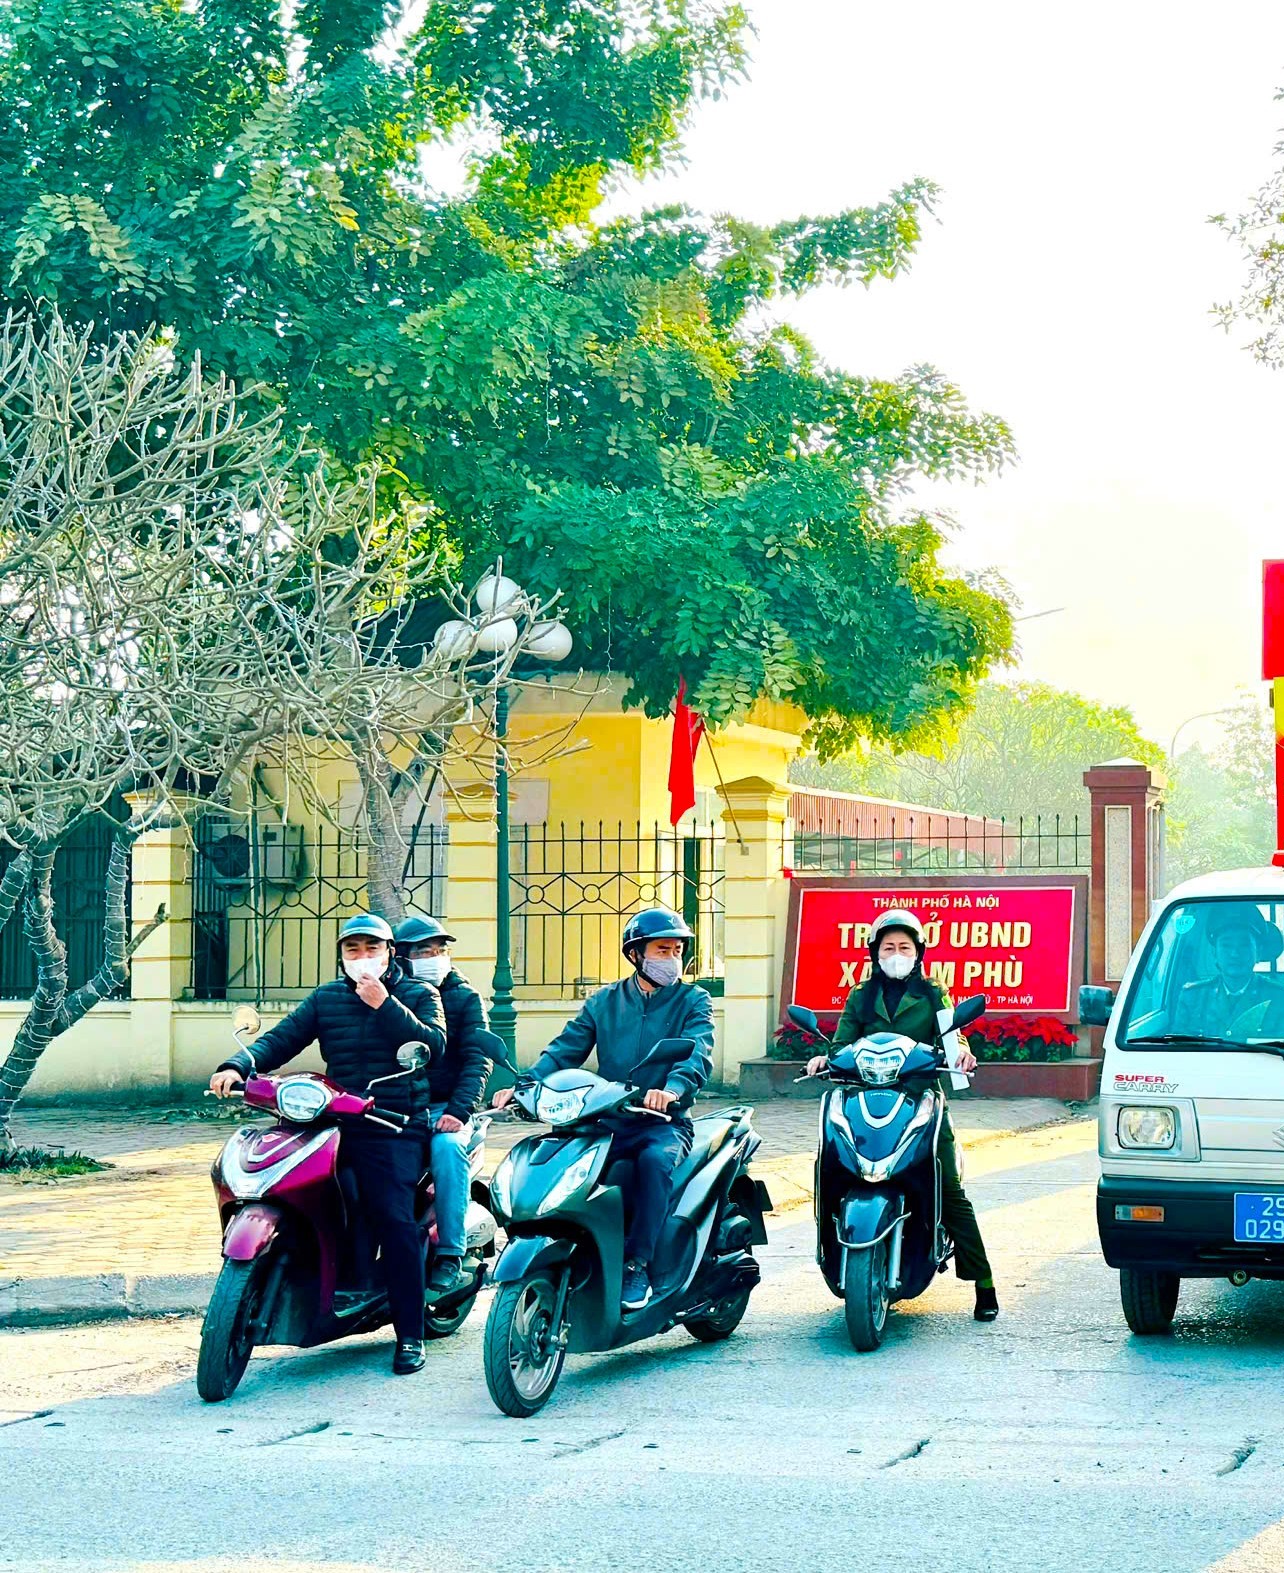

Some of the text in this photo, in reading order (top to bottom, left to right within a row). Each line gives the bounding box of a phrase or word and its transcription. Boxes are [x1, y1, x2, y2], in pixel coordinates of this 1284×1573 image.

[872, 893, 1000, 910] THÀNH PHỐ HÀ NỘI
[838, 923, 872, 949] TR
[949, 921, 1032, 948] UBND
[963, 954, 1023, 988] PHÙ
[996, 996, 1007, 1004] TP
[1008, 995, 1018, 1004] HÀ
[1020, 993, 1034, 1006] NỘI
[1114, 1074, 1165, 1083] SUPER
[1113, 1082, 1179, 1093] CARRY
